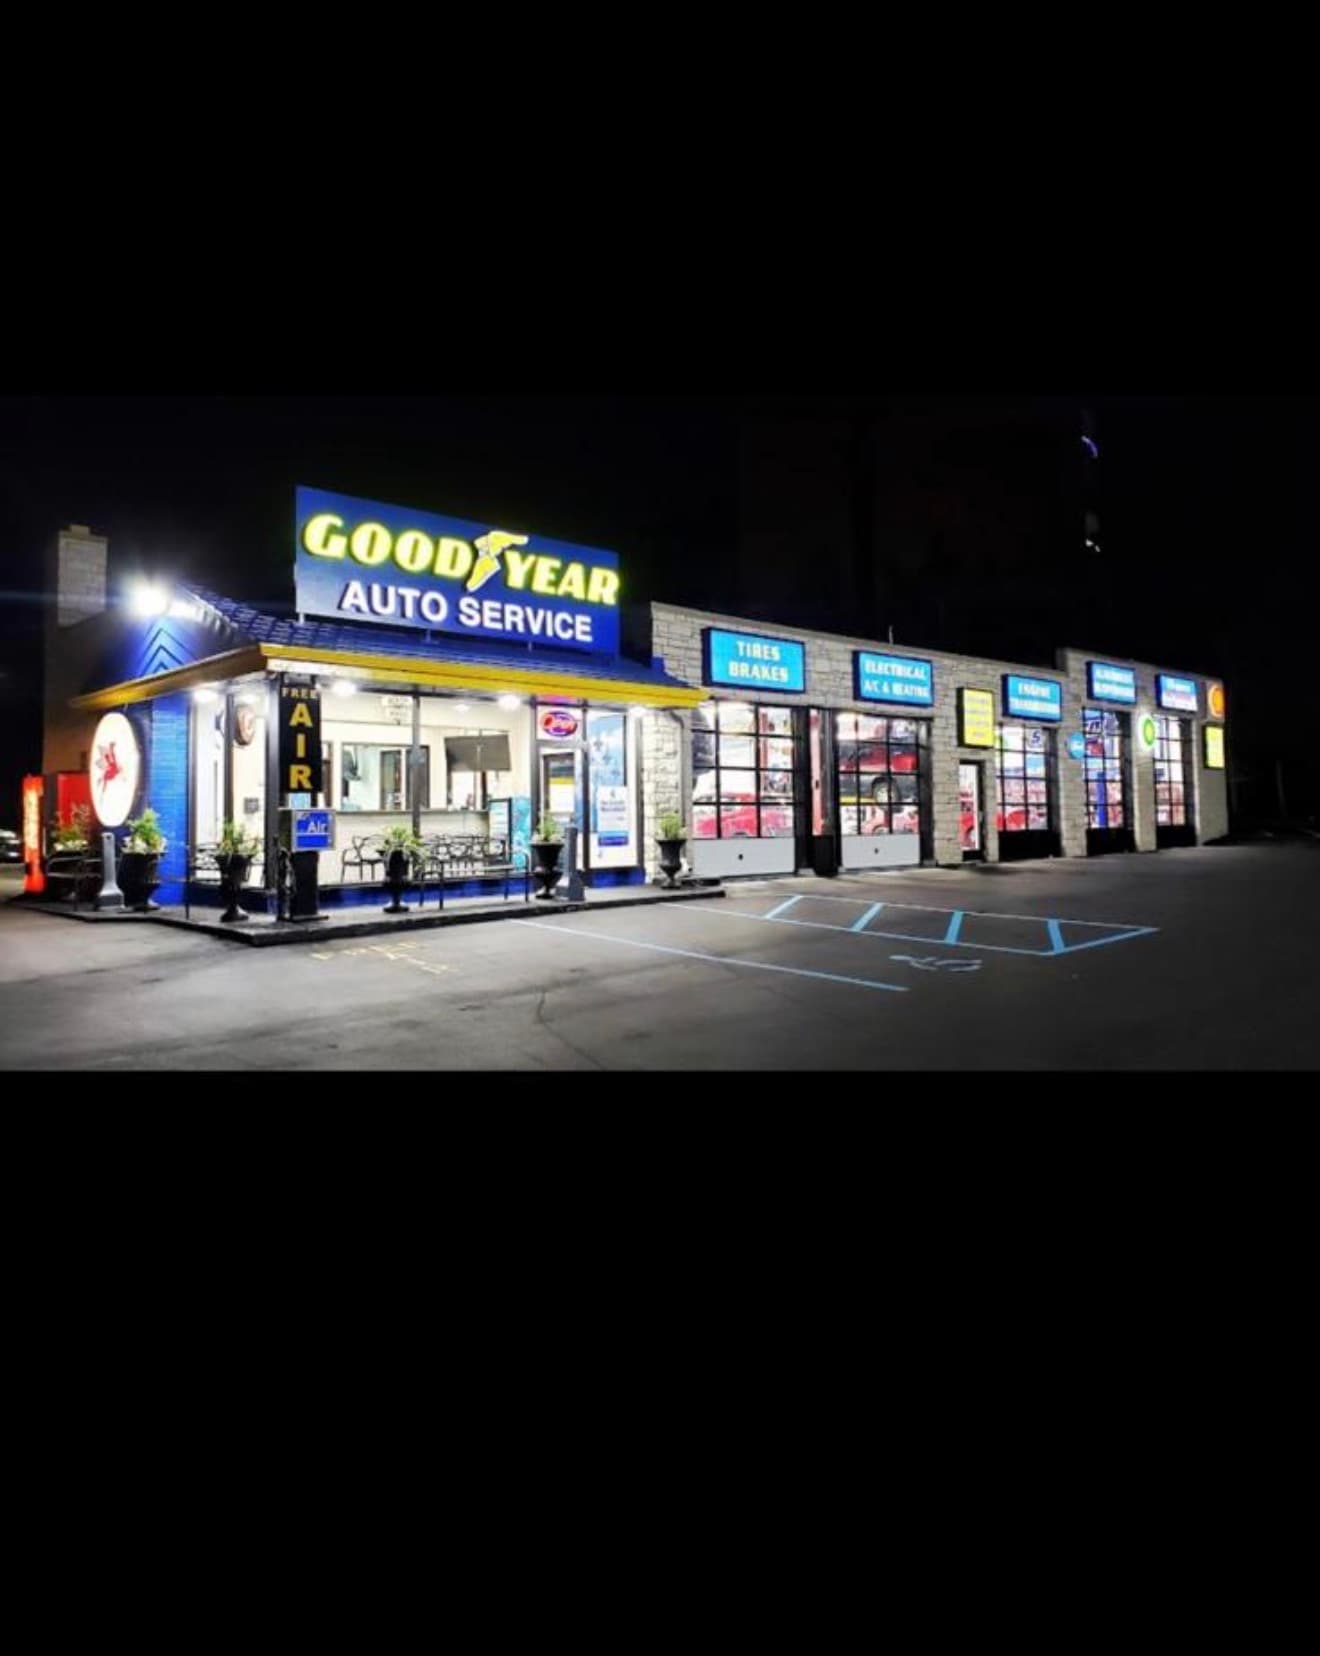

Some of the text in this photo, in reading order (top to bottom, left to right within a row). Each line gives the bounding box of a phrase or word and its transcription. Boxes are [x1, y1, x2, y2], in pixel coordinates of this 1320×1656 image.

[341, 580, 593, 642] AUTO SERVICE
[736, 640, 780, 661] TIRES
[728, 660, 789, 683] BRAKES
[865, 661, 927, 680] ELECTRICAL
[281, 687, 318, 699] FREE
[289, 702, 314, 790] AIR
[307, 823, 327, 834] Air
